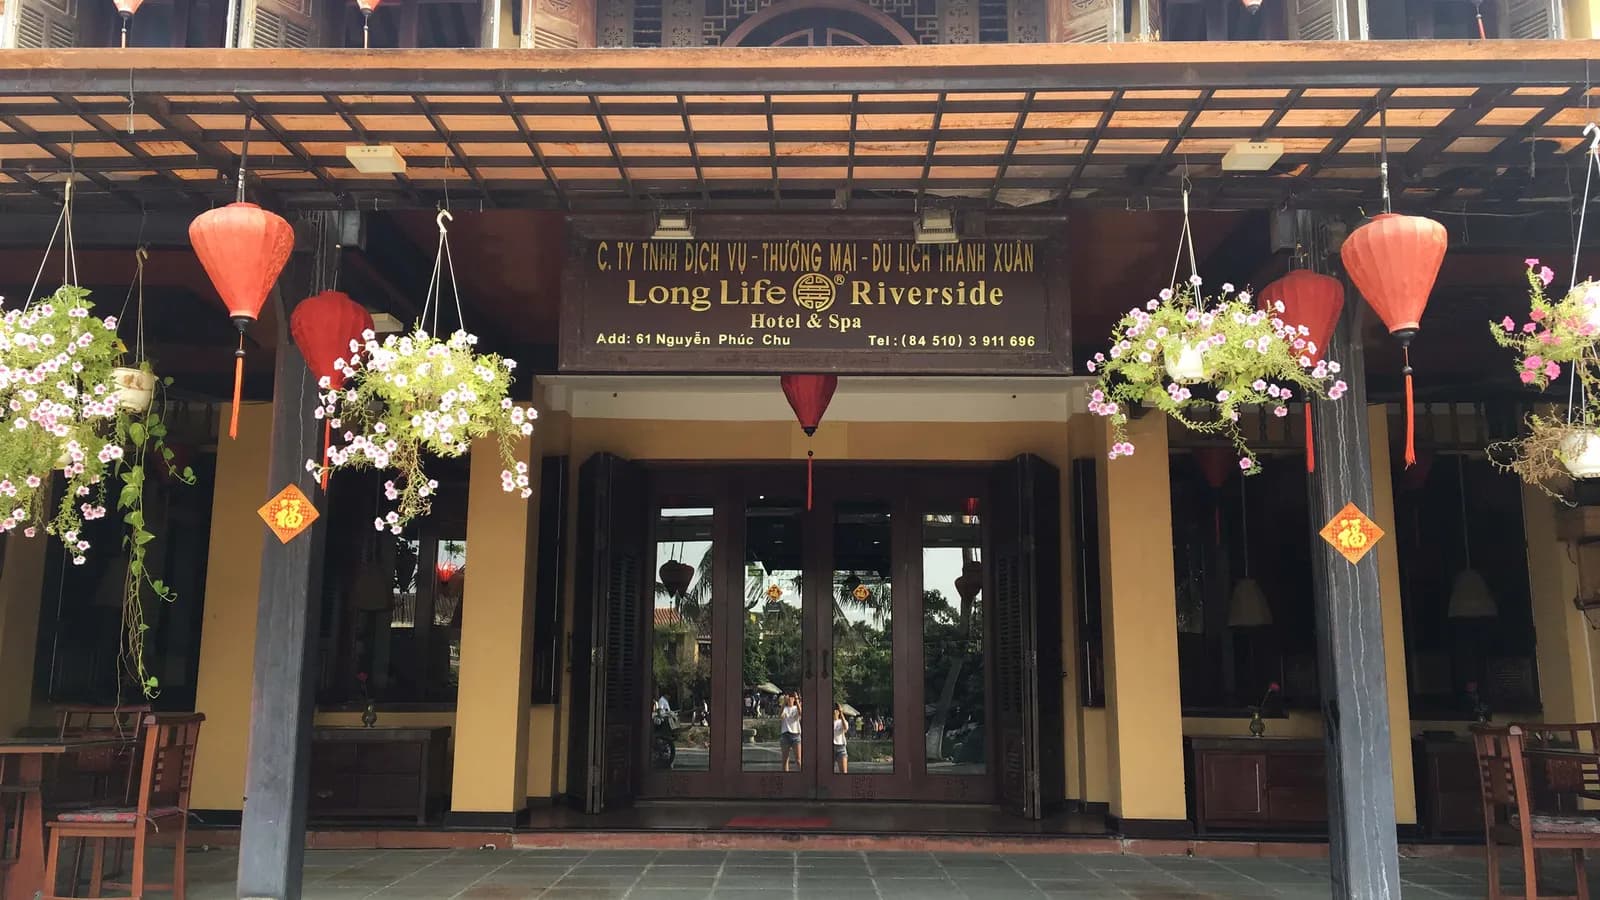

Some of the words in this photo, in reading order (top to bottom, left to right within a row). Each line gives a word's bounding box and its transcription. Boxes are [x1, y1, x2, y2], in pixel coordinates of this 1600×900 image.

[598, 241, 612, 271] C.
[617, 242, 634, 271] TY
[642, 242, 677, 271] TNHH
[685, 242, 719, 274] DỊCH
[727, 242, 747, 275] VỤ
[762, 240, 822, 271] THƯƠNG
[830, 243, 857, 274] MẠI
[873, 243, 892, 272] DU
[899, 243, 931, 275] LỊCH
[939, 243, 986, 272] THANH
[994, 240, 1034, 272] XUÂN
[627, 279, 711, 311] Long
[720, 279, 786, 305] Life
[850, 280, 1004, 305] Riverside
[750, 314, 800, 329] Hotel
[806, 313, 822, 328] &
[828, 314, 862, 333] Spa
[596, 333, 631, 344] Add:
[635, 334, 651, 345] 61
[656, 331, 711, 347] Nguyễn
[718, 333, 754, 345] Phúc
[762, 334, 791, 345] Chu
[932, 334, 962, 347] 510)
[969, 336, 977, 346] 3
[982, 336, 1004, 346] 911
[1009, 336, 1036, 346] 696
[275, 499, 303, 528] 福
[1337, 518, 1367, 548] 福
